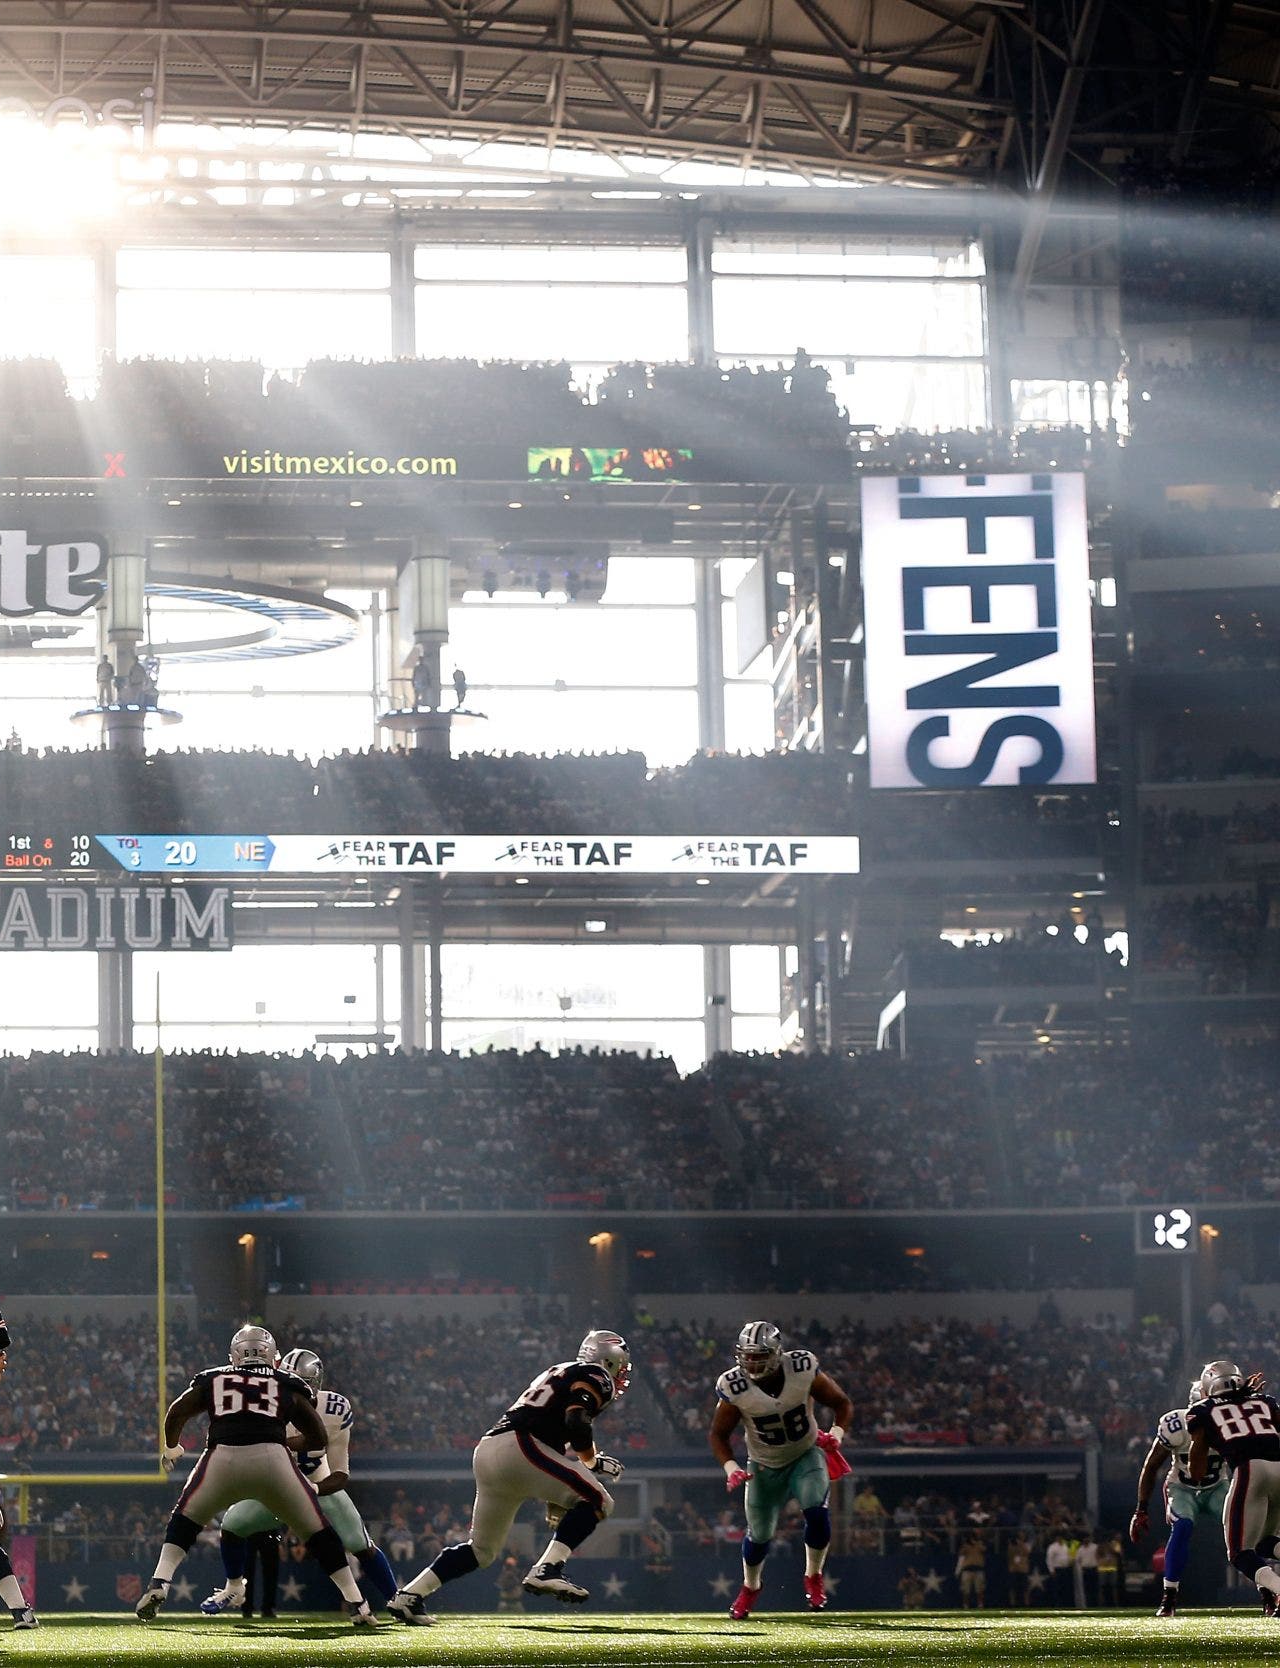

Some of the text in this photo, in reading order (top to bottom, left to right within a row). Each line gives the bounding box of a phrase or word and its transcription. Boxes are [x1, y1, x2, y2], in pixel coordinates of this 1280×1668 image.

[223, 449, 457, 475] visitmexico.com
[8, 835, 90, 850] 1st & 10
[233, 842, 267, 861] NE
[343, 841, 386, 851] FEAR
[520, 841, 563, 852] FEAR
[697, 842, 740, 852] FEAR
[5, 851, 90, 866] Ball On 20
[130, 852, 140, 866] 3
[164, 841, 198, 865] 20
[356, 856, 386, 866] THE
[389, 842, 456, 866] TAF
[534, 856, 564, 866] THE
[566, 842, 633, 866] TAF
[711, 856, 740, 867] THE
[742, 843, 808, 866] TAF
[1154, 1208, 1192, 1250] 12
[790, 1351, 812, 1373] 58
[212, 1373, 280, 1418] 63
[751, 1403, 810, 1446] 58
[1210, 1400, 1278, 1441] 82
